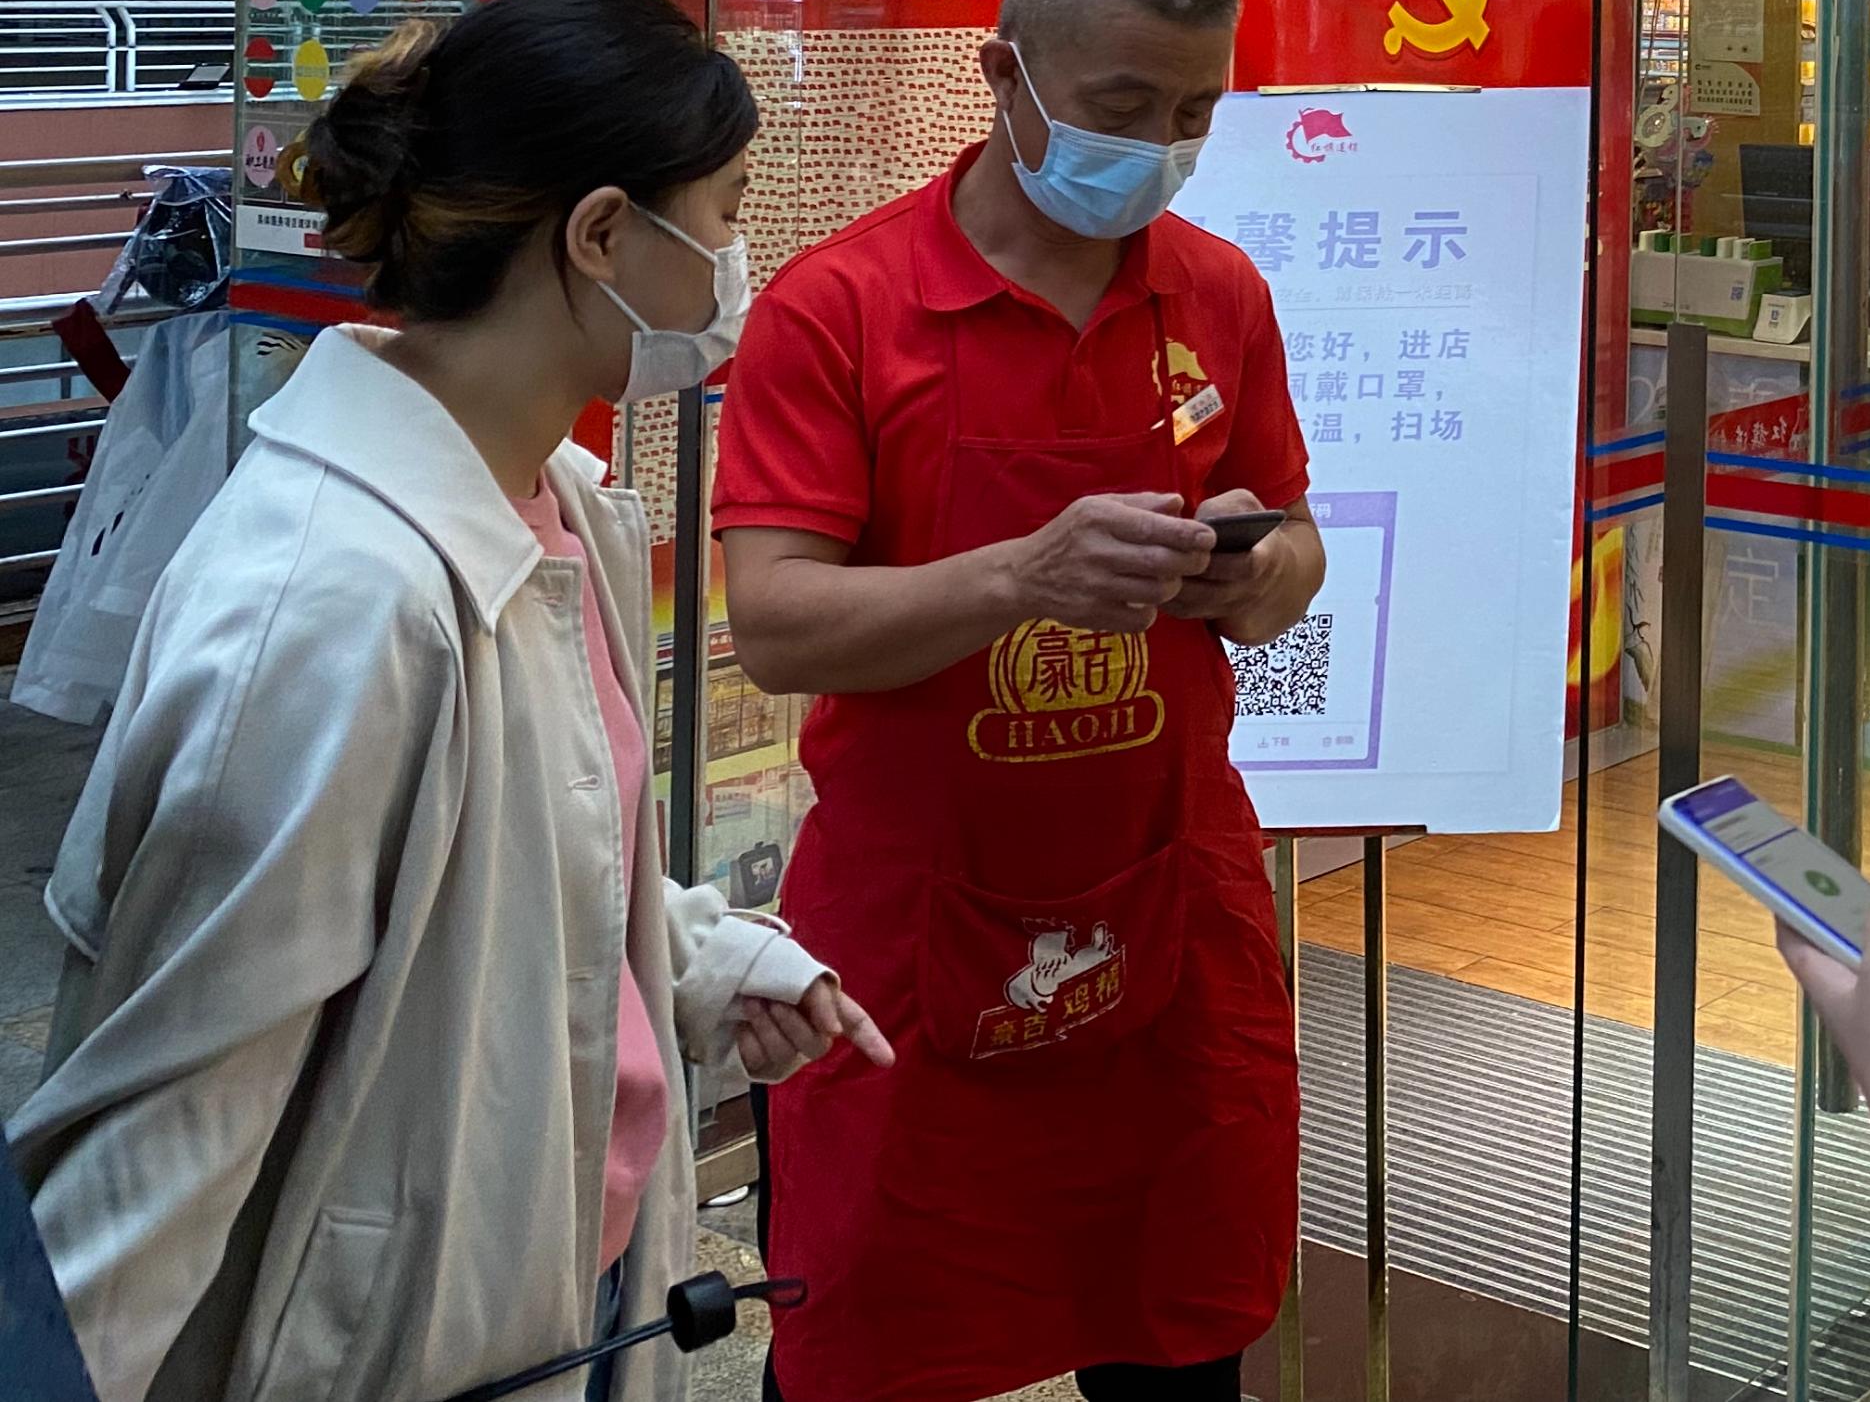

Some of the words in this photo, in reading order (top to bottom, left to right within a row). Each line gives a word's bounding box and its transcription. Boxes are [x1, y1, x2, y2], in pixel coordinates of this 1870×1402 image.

[1285, 328, 1471, 363] 您好，进店
[1299, 409, 1464, 444] 温，扫场
[1027, 625, 1115, 704] 豪吉
[1008, 705, 1136, 749] HAOJI
